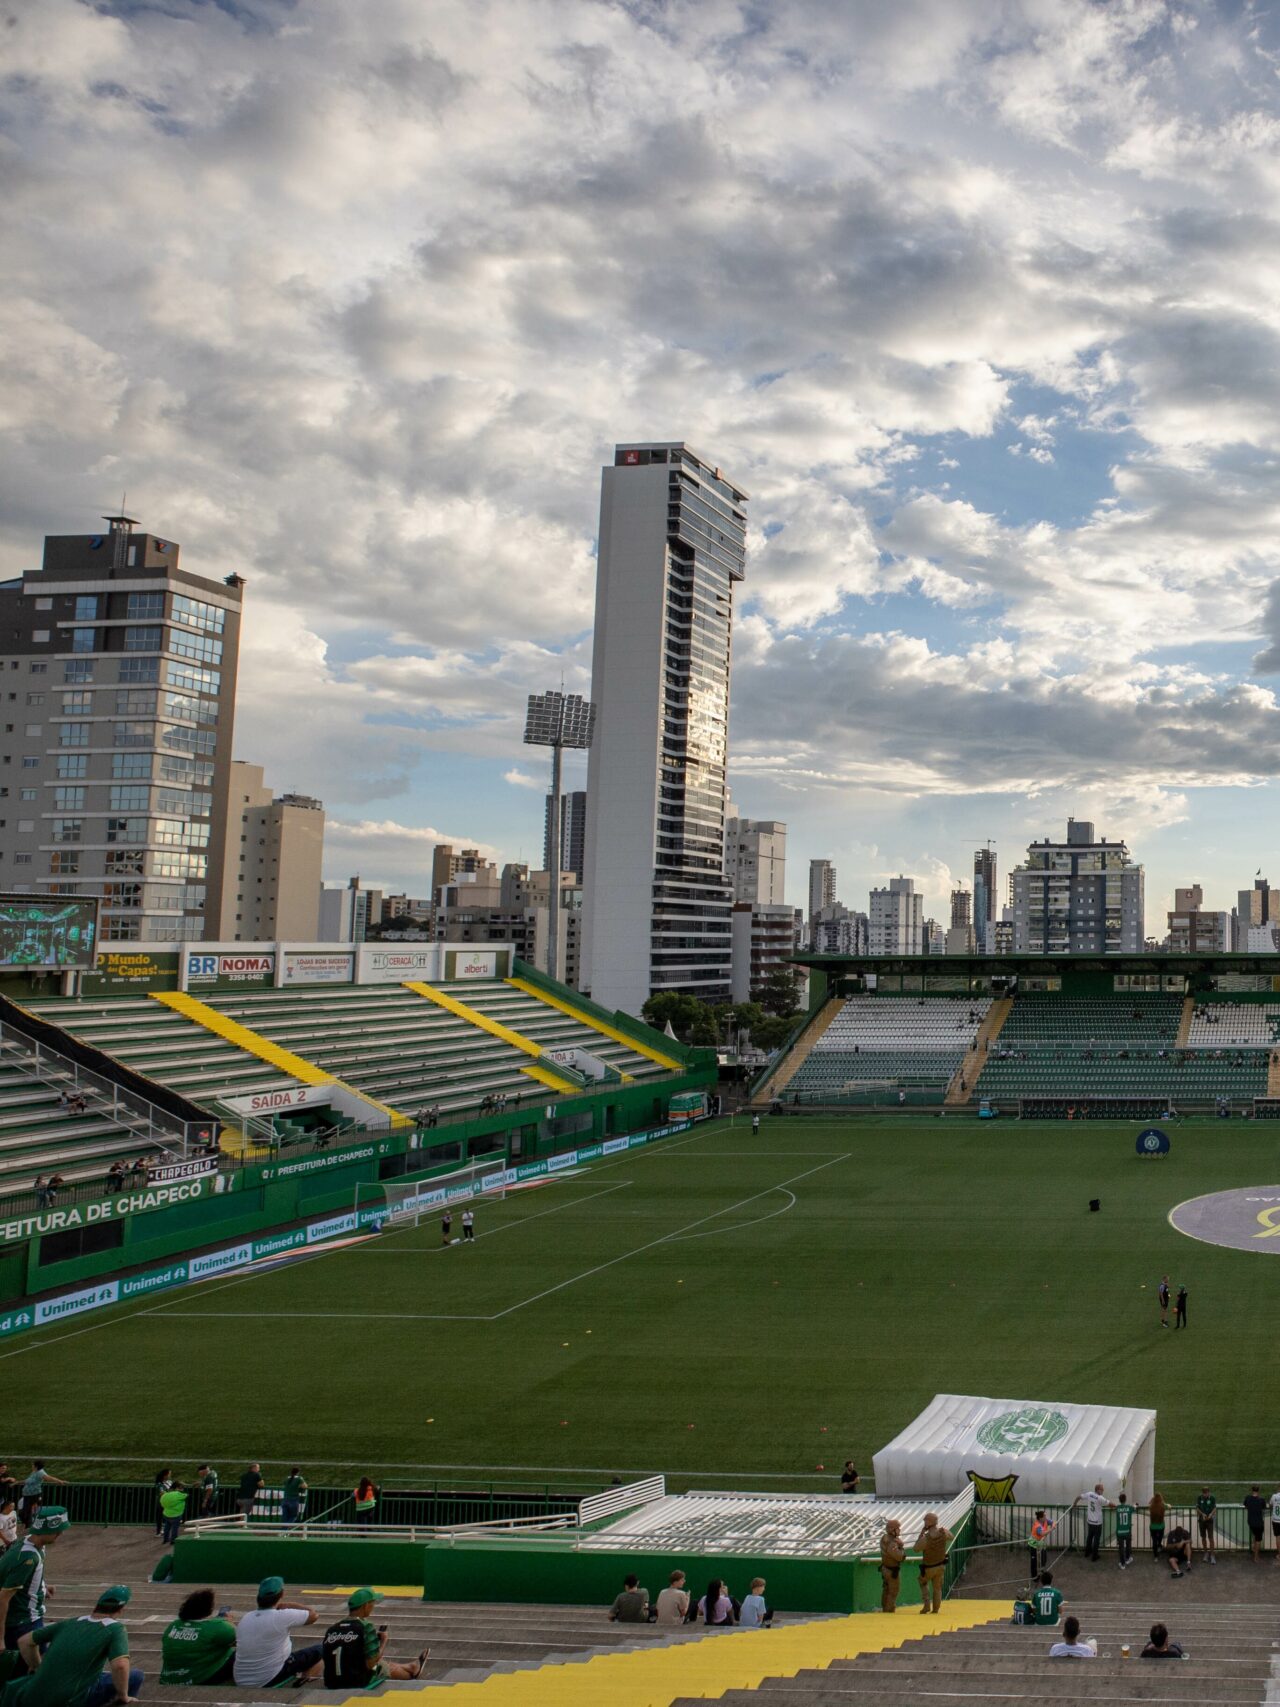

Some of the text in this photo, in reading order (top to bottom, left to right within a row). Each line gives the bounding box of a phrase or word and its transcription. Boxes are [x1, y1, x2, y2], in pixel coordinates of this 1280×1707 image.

[108, 953, 150, 965] Mundo
[188, 957, 216, 974] BR
[222, 959, 271, 971] NOMA
[118, 964, 157, 976] Capas!
[464, 964, 488, 973] alberti
[569, 1051, 575, 1060] 3
[251, 1090, 306, 1109] SAÍDA 2
[155, 1159, 212, 1181] CHAPEGALO
[278, 1158, 327, 1176] PREFEITURA
[327, 1157, 338, 1165] DE
[550, 1156, 570, 1168] Unimed
[518, 1164, 540, 1177] Unimed
[87, 1201, 112, 1221] DE
[116, 1179, 202, 1215] CHAPECÓ
[406, 1196, 435, 1210] Unmed
[360, 1207, 392, 1223] Unimed
[311, 1220, 345, 1238] Unimed
[255, 1236, 293, 1255] Unimed
[193, 1253, 236, 1273] Unimed
[123, 1270, 171, 1294] Unimed
[42, 1293, 96, 1318] Unimed
[1090, 1501, 1096, 1512] 5
[1120, 1512, 1128, 1525] 10
[1041, 1597, 1052, 1615] 10
[1015, 1611, 1024, 1625] 10
[332, 1646, 342, 1676] 1
